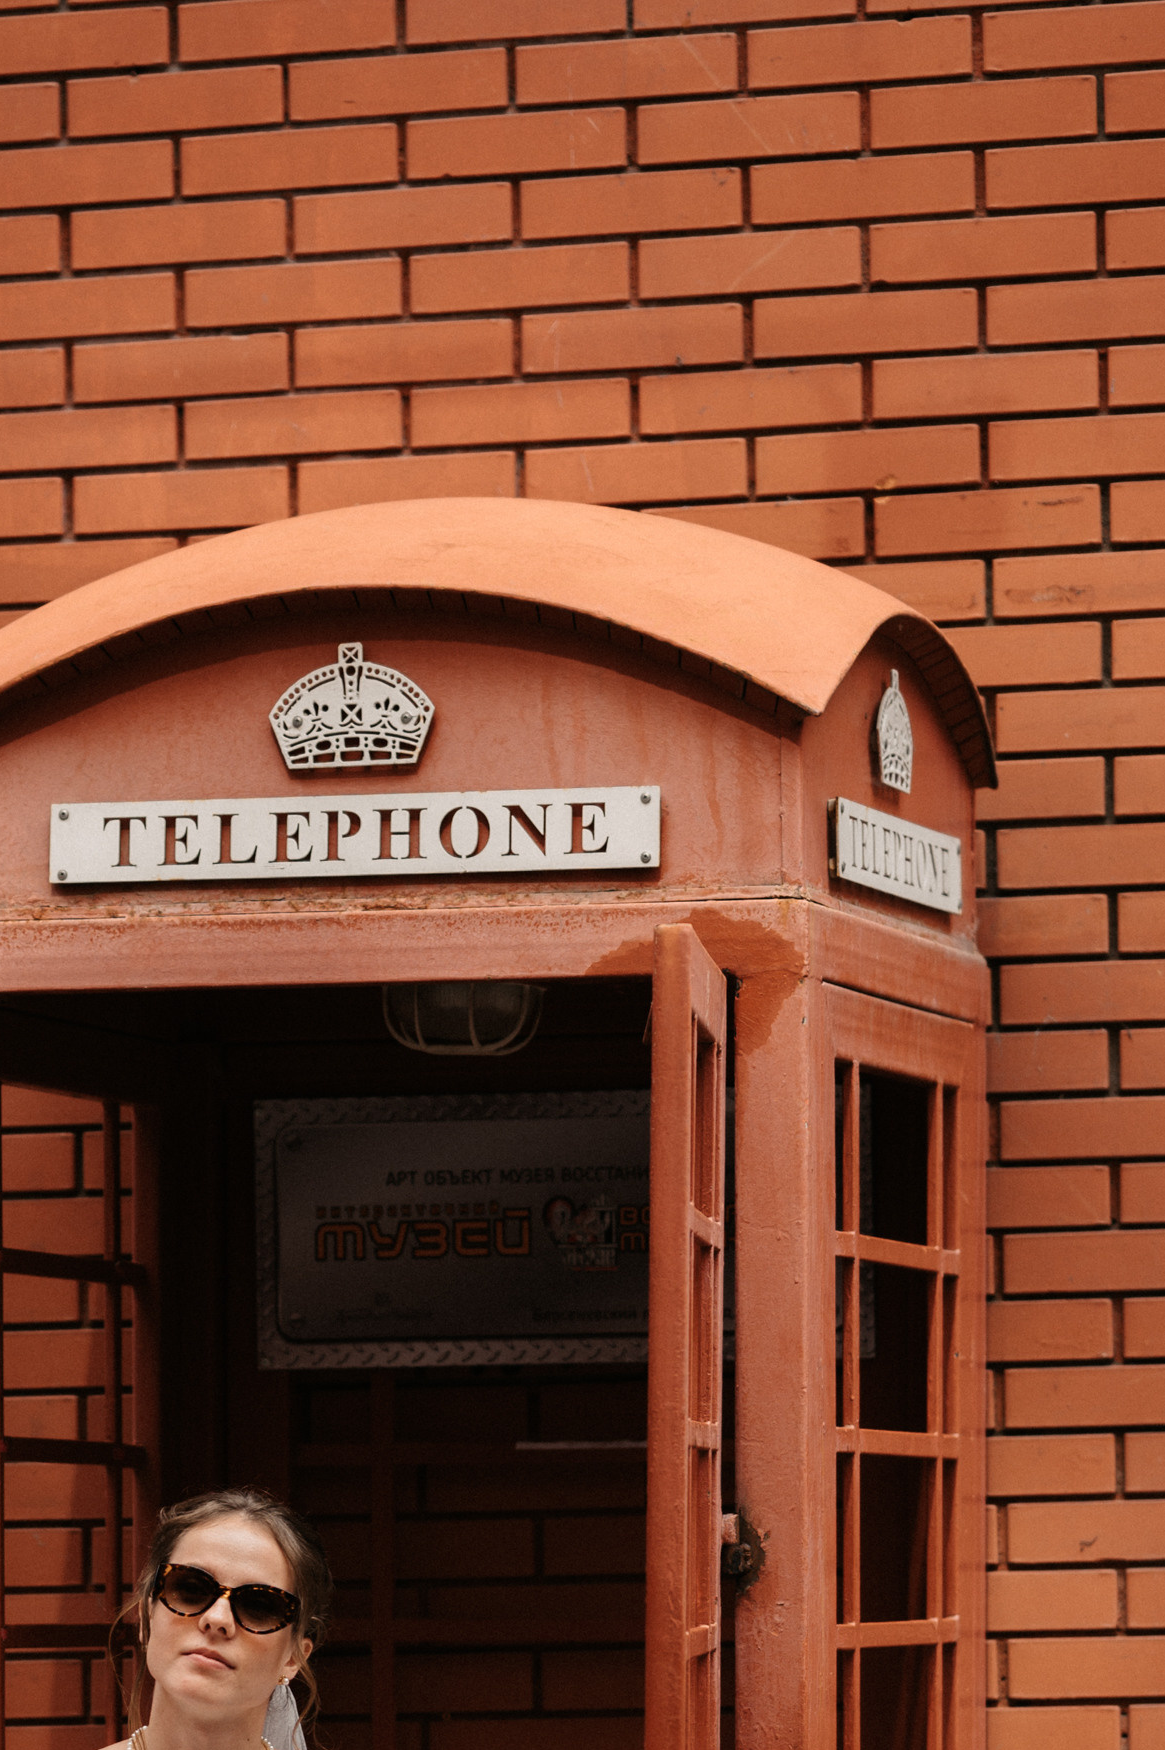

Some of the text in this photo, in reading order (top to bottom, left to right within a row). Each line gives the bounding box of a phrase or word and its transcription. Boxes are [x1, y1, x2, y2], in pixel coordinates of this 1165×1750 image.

[102, 801, 611, 868] TELEPHONE
[848, 815, 950, 898] TELEPHONE
[385, 1164, 649, 1187] АРТ ОБЪЕКТ МУЗЕЯ ВОССТАНИ
